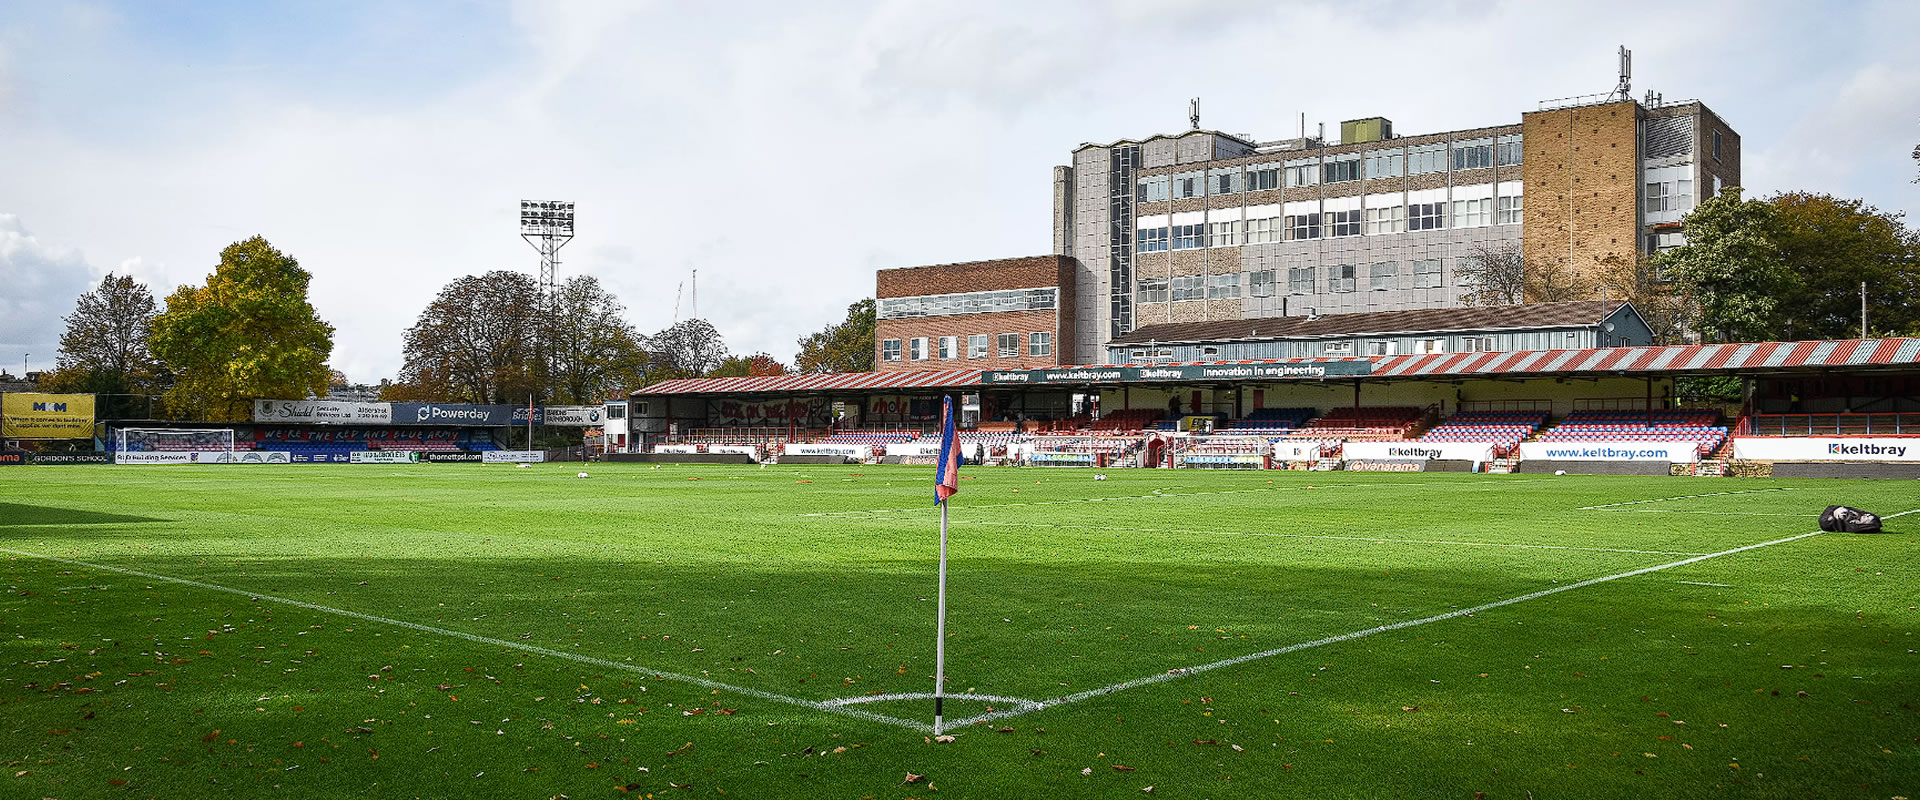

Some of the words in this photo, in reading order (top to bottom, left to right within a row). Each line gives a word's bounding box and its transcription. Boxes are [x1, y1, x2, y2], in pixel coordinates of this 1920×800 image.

[1046, 370, 1120, 380] www.keltbray.com
[1203, 367, 1252, 377] Innovation
[1254, 367, 1263, 375] in
[1265, 365, 1325, 377] engineering
[33, 402, 67, 412] MKM
[278, 402, 315, 418] Shield
[432, 407, 490, 421] Powerday
[265, 430, 301, 438] WE'RE
[308, 431, 331, 440] THE
[336, 430, 358, 439] RED
[363, 430, 387, 439] AND
[393, 430, 422, 440] BLUE
[427, 430, 459, 440] ARMY
[800, 447, 856, 456] www.keltbray.com
[1398, 447, 1442, 458] keltbray
[1546, 447, 1668, 460] www.keltbray.com
[1841, 443, 1906, 457] keltbray
[429, 452, 482, 461] thornettpsl.com
[1364, 461, 1420, 472] vanarama
